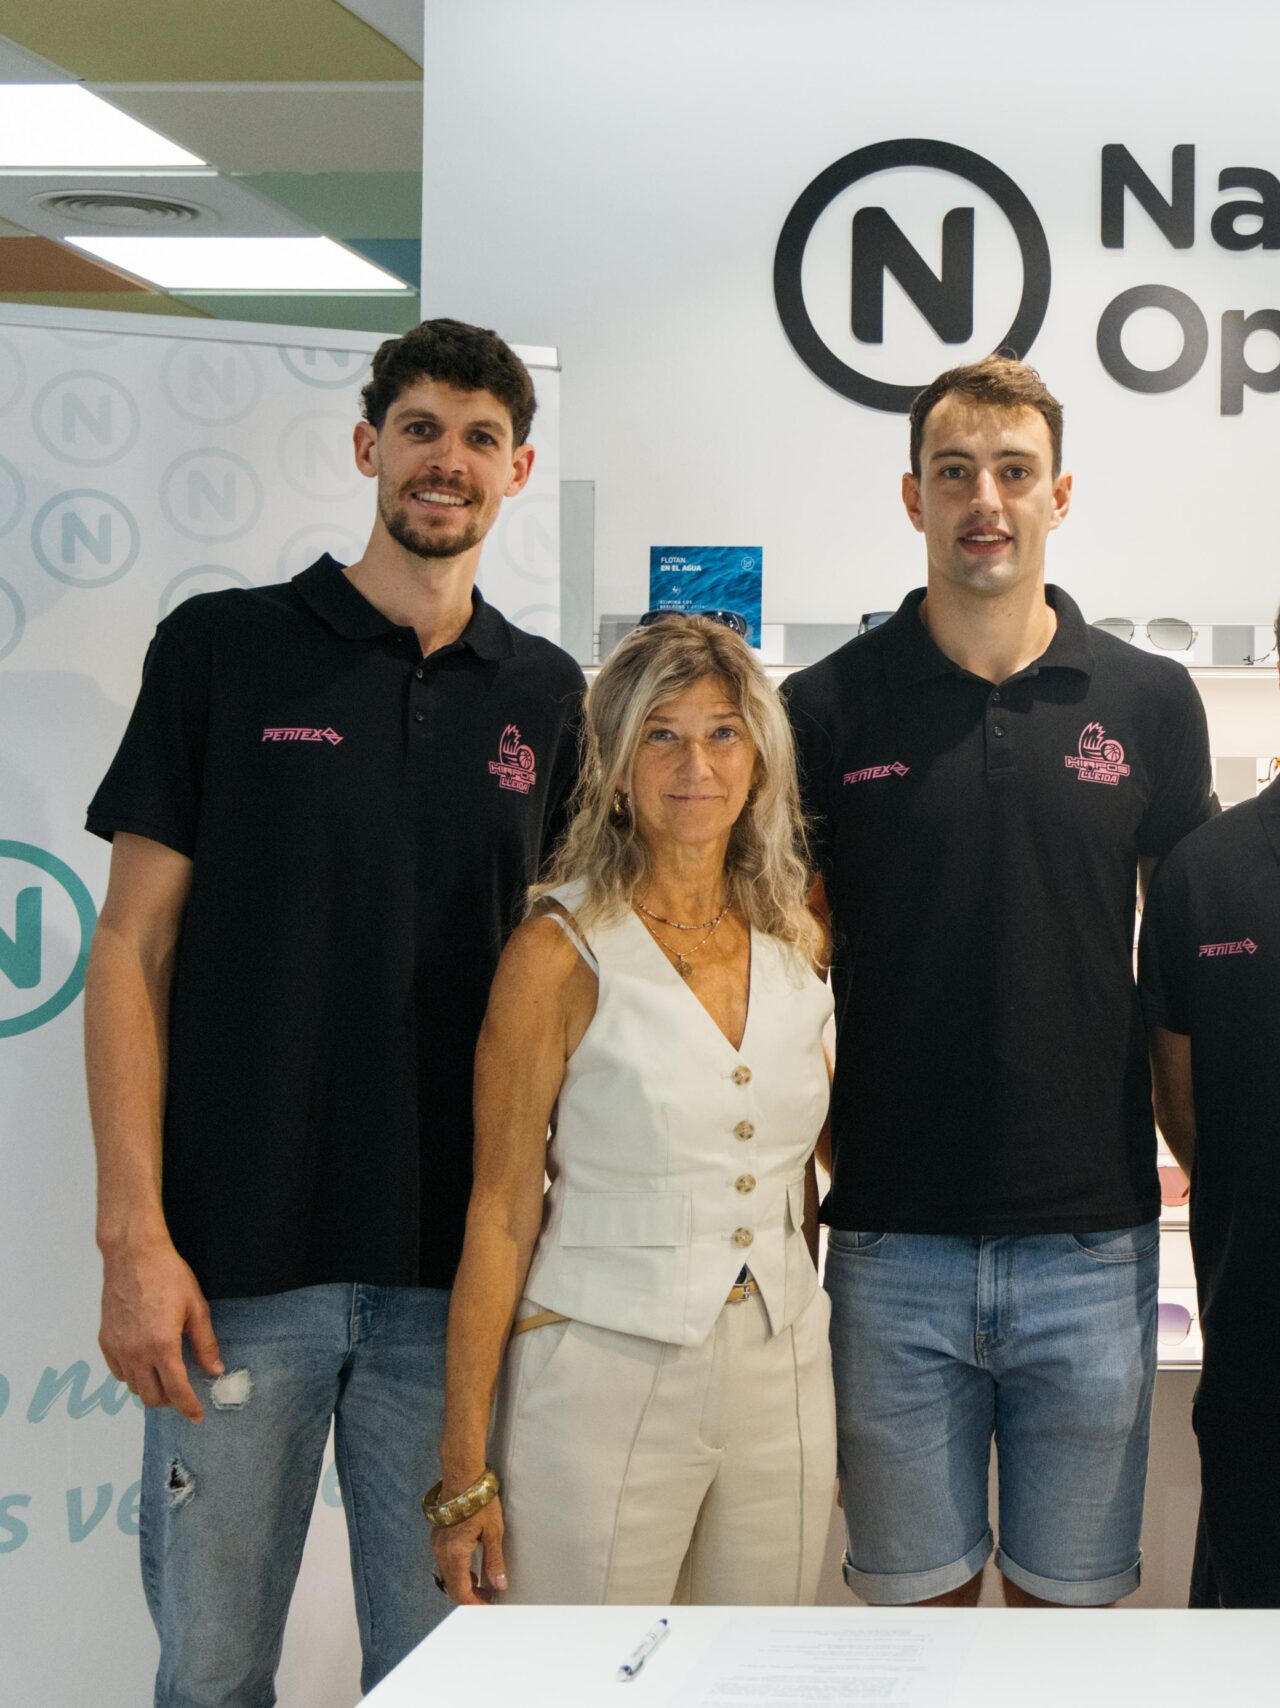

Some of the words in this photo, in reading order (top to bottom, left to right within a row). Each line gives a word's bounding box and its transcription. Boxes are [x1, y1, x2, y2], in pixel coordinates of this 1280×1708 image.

[850, 206, 975, 344] N
[660, 556, 686, 564] FLOTAN
[262, 727, 323, 742] PENTEX
[842, 764, 893, 786] PENTEX
[1080, 770, 1118, 783] LLEIDA
[1198, 941, 1244, 957] PENTEX
